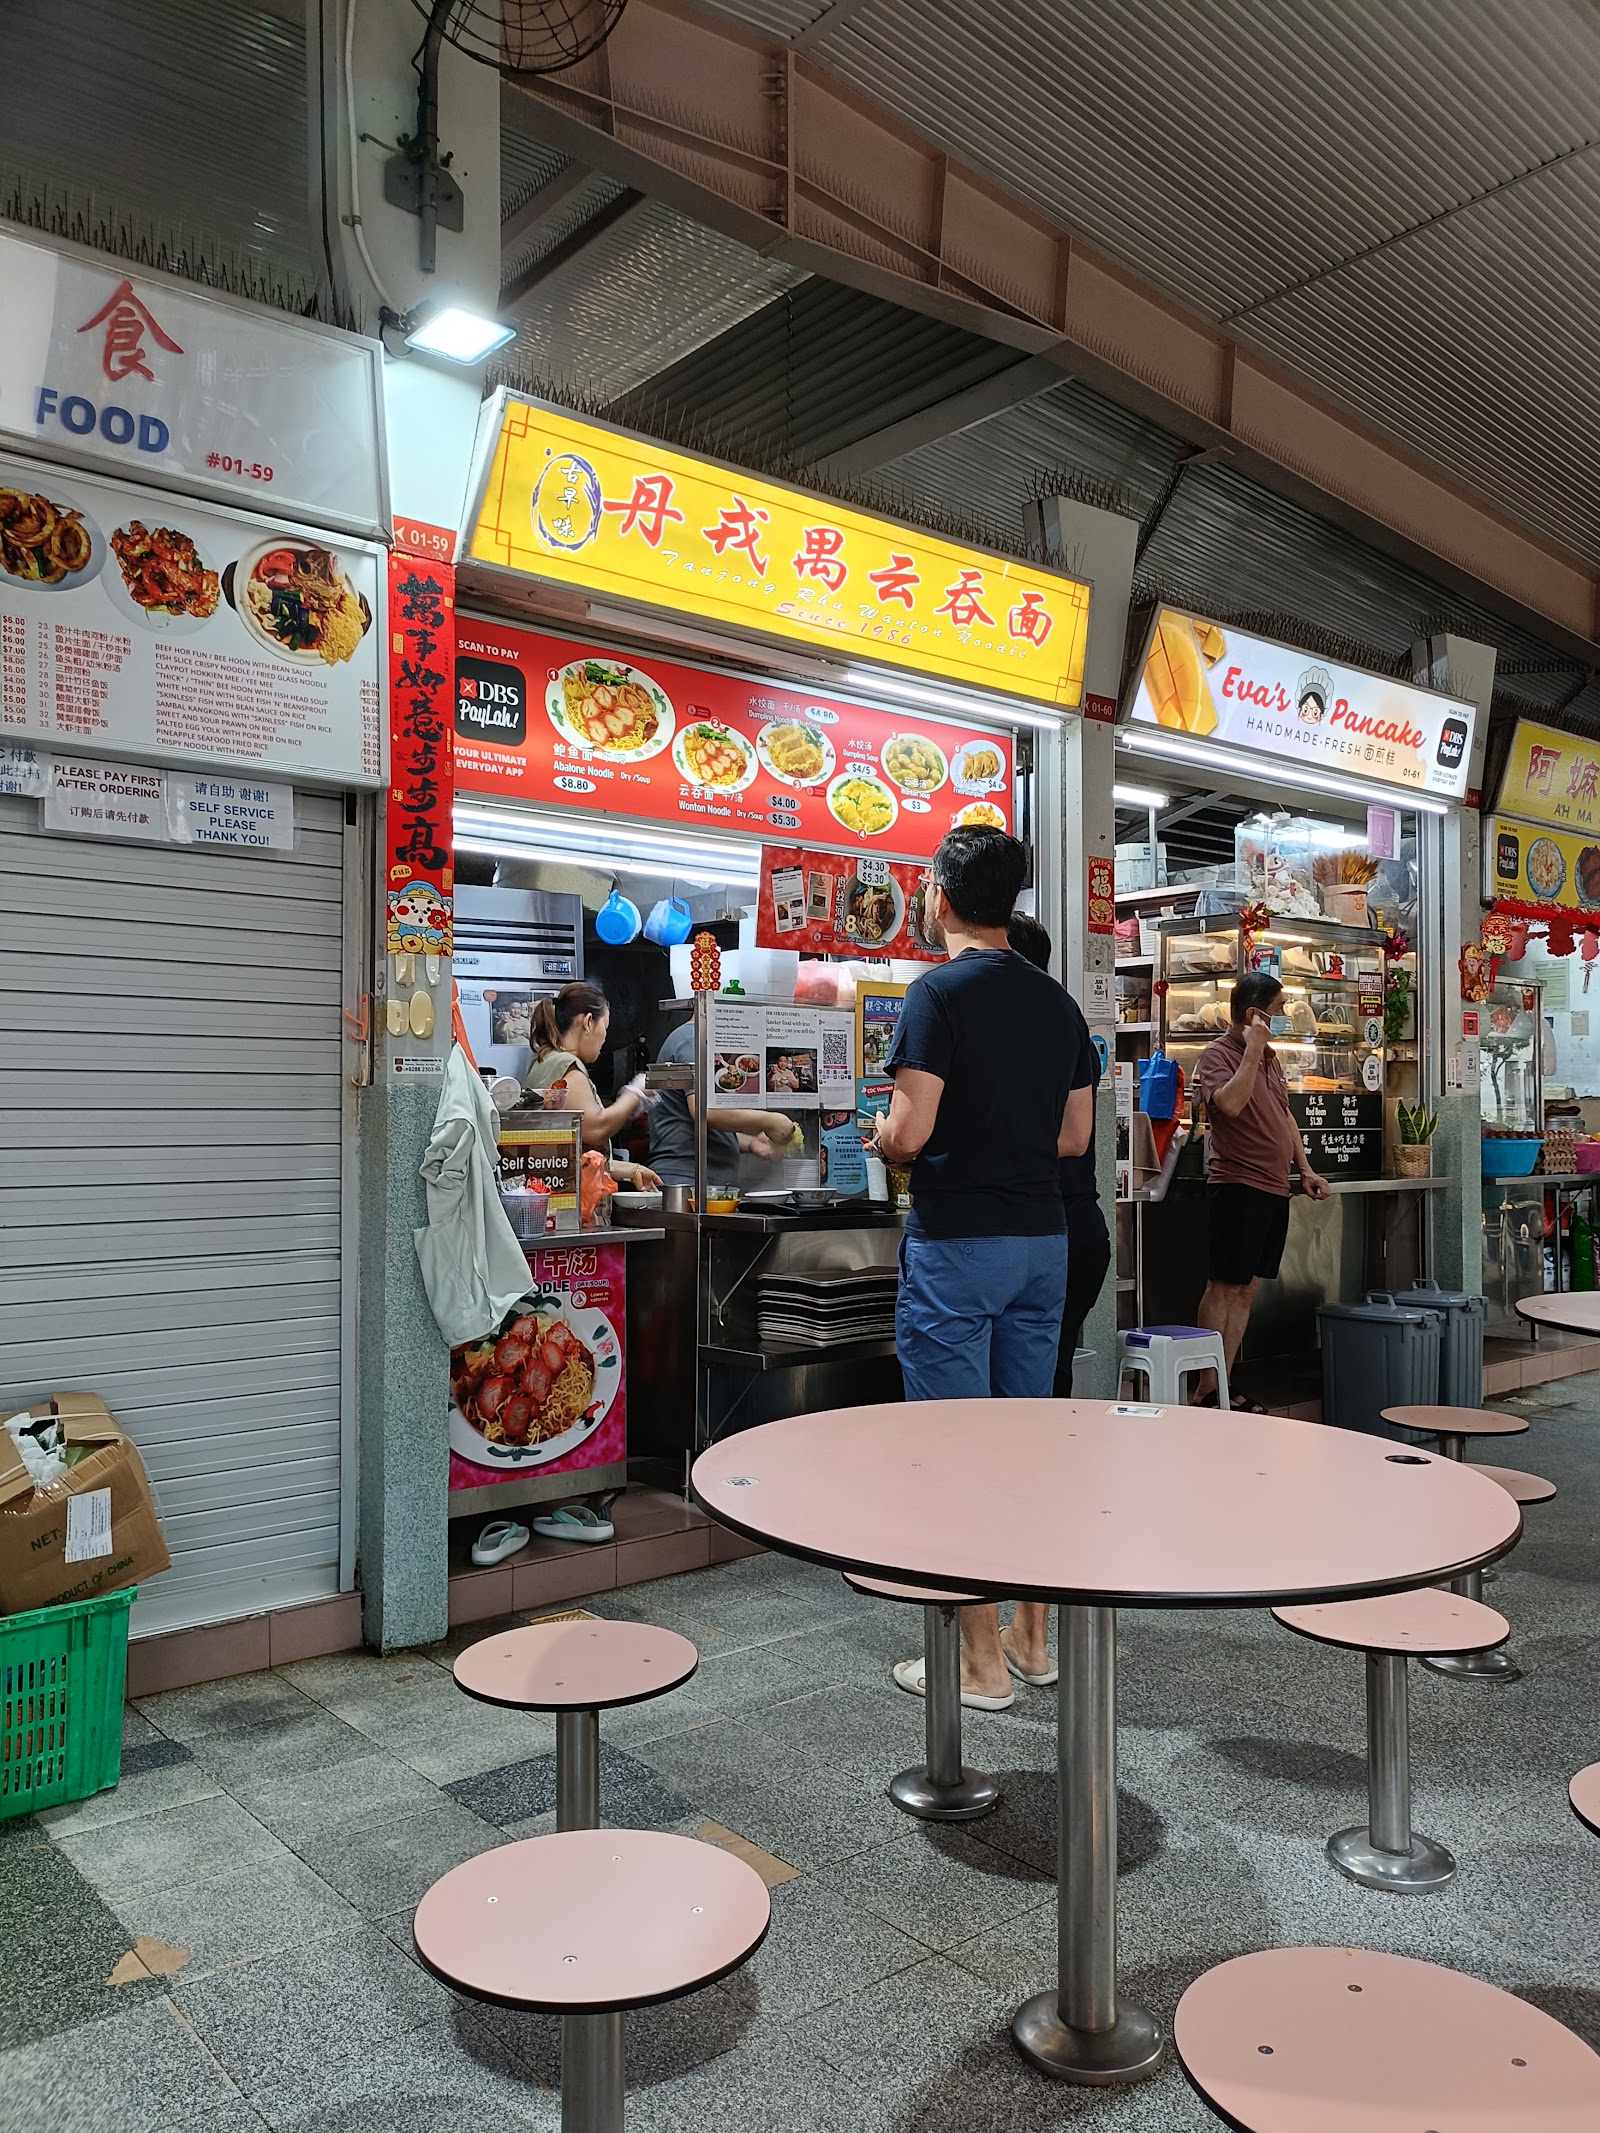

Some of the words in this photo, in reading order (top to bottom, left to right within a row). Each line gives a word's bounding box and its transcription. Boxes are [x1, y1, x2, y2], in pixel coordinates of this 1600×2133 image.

[75, 279, 184, 381] 食
[35, 387, 170, 453] FOOD
[206, 452, 273, 482] #01-59
[552, 461, 583, 537] 古早味
[410, 532, 448, 551] 01-59
[603, 474, 1054, 648] 丹戎禺云吞面
[660, 549, 776, 596] Tanjong
[796, 586, 844, 611] Rhu
[858, 603, 942, 638] Wanton
[956, 629, 1028, 659] Noodle
[2, 616, 25, 625] $6.00
[775, 602, 847, 629] Since
[859, 622, 912, 645] 1986
[2, 625, 25, 635] $5.00
[458, 639, 484, 653] SCAN
[486, 645, 499, 655] TO
[501, 648, 519, 659] PAY
[155, 643, 173, 653] BEEF
[174, 646, 190, 656] HOR
[193, 650, 208, 659] FUN
[214, 654, 226, 663] BEE
[228, 656, 250, 667] HOON
[252, 660, 270, 670] WITH
[272, 664, 290, 674] BEAN
[292, 668, 312, 678] SAUCE
[550, 670, 557, 680] 1
[479, 681, 519, 705] DBS
[459, 699, 519, 728] PayLah!
[1092, 702, 1112, 715] 01-60
[1222, 666, 1291, 712] Eva's
[1330, 699, 1427, 748] Pancake
[4, 714, 26, 724] $5.50
[712, 719, 718, 727] 2
[749, 710, 774, 722] Dumpling
[156, 728, 195, 740] PINEAPPLE
[198, 734, 230, 745] SEAFOOD
[233, 739, 252, 748] FRIED
[254, 741, 268, 751] RICE
[891, 731, 896, 740] 5
[1450, 731, 1464, 745] DBS
[453, 746, 479, 760] YOUR
[481, 751, 527, 767] ULTIMATE
[842, 749, 865, 761] Dumpling
[866, 753, 878, 762] Soup
[1364, 744, 1395, 766] 面煎糕
[1441, 742, 1461, 757] PayLah!
[455, 759, 503, 775] EVERYDAY
[506, 766, 524, 777] APP
[553, 761, 586, 775] Abalone
[588, 766, 614, 780] Noodle
[621, 771, 631, 783] Dry
[853, 764, 871, 775] $4/5
[1403, 769, 1420, 779] 01-61
[54, 765, 101, 779] PLEASE
[104, 771, 128, 782] PAY
[131, 775, 162, 787] FIRST
[56, 779, 97, 791] AFTER
[99, 784, 160, 799] ORDERING
[194, 782, 234, 798] 请自助
[561, 777, 588, 791] $8.80
[794, 780, 800, 789] 3
[678, 783, 714, 801] 云吞面
[189, 801, 220, 813] SELF
[223, 804, 275, 819] SERVICE
[678, 800, 706, 814] Wonton
[707, 803, 731, 817] Noodle
[736, 809, 747, 820] Dry
[771, 796, 796, 809] $4.00
[912, 801, 921, 810] $3
[771, 813, 796, 826] $5.30
[1577, 809, 1592, 823] MA
[209, 817, 256, 831] PLEASE
[196, 829, 238, 842] THANK
[240, 833, 269, 845] YOU!
[859, 830, 866, 839] 4
[1505, 846, 1517, 857] DBS
[862, 860, 885, 872] $4.30
[862, 872, 884, 884] $5.30
[1091, 867, 1112, 898] 福
[845, 915, 856, 932] 8
[1309, 1095, 1324, 1106] 红豆
[1306, 1107, 1314, 1115] Red
[1310, 1117, 1322, 1126] $1.20
[1344, 1117, 1356, 1126] $1.20
[502, 1157, 525, 1170] Self
[528, 1156, 568, 1169] Service
[545, 1176, 564, 1187] 20¢
[30, 1528, 63, 1552] NET:
[44, 1581, 89, 1608] PRODUCT
[91, 1571, 104, 1584] OF
[107, 1556, 135, 1576] CHINA
